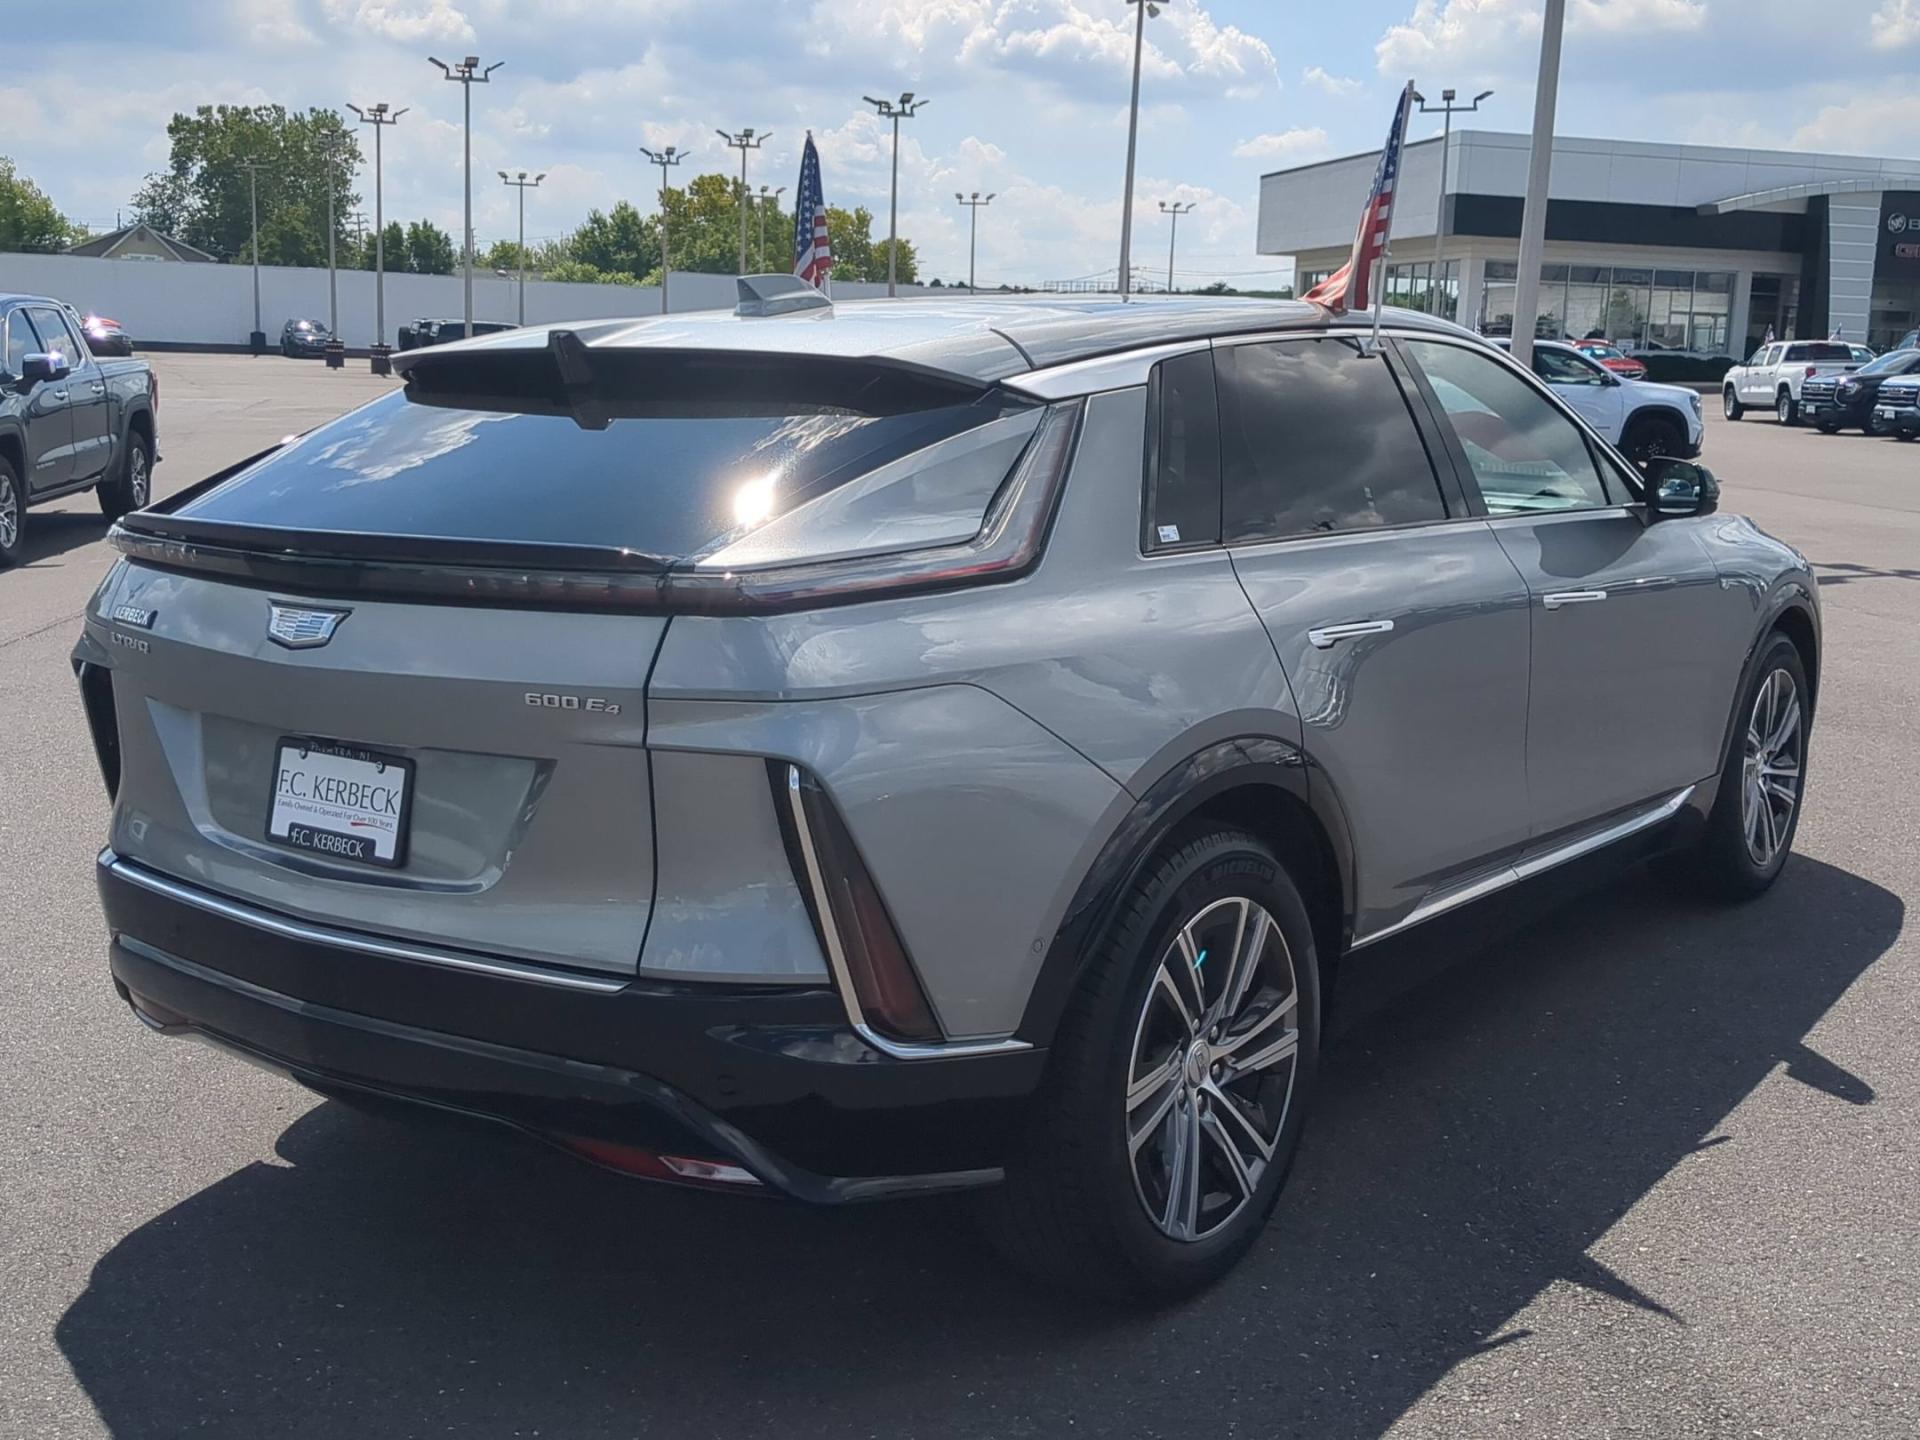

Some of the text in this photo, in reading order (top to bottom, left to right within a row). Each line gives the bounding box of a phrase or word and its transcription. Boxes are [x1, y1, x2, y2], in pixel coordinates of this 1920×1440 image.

[525, 692, 620, 715] 600 E4
[278, 769, 400, 815] F.C. KERBECK
[294, 802, 313, 813] Owned
[319, 807, 343, 818] Operated
[344, 812, 352, 820] For
[352, 813, 366, 822] Over
[313, 833, 365, 858] KERBECK
